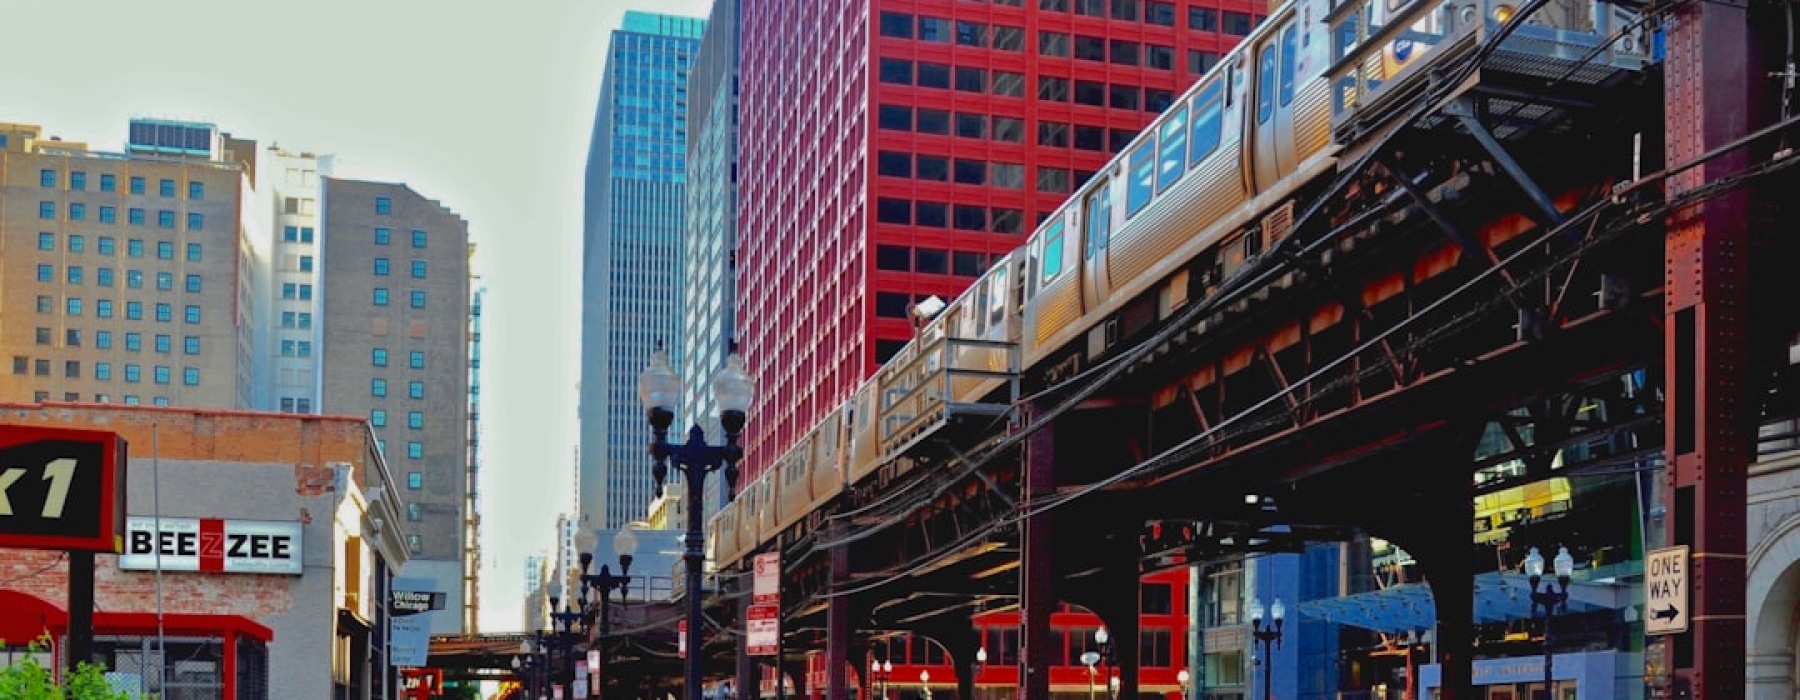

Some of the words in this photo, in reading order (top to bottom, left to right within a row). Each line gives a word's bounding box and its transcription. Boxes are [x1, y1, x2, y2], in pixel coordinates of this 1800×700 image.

[41, 458, 78, 518] 1
[1651, 554, 1681, 577] ONE
[393, 591, 430, 602] Willow
[1649, 577, 1681, 600] WAY
[394, 601, 429, 612] Chicago
